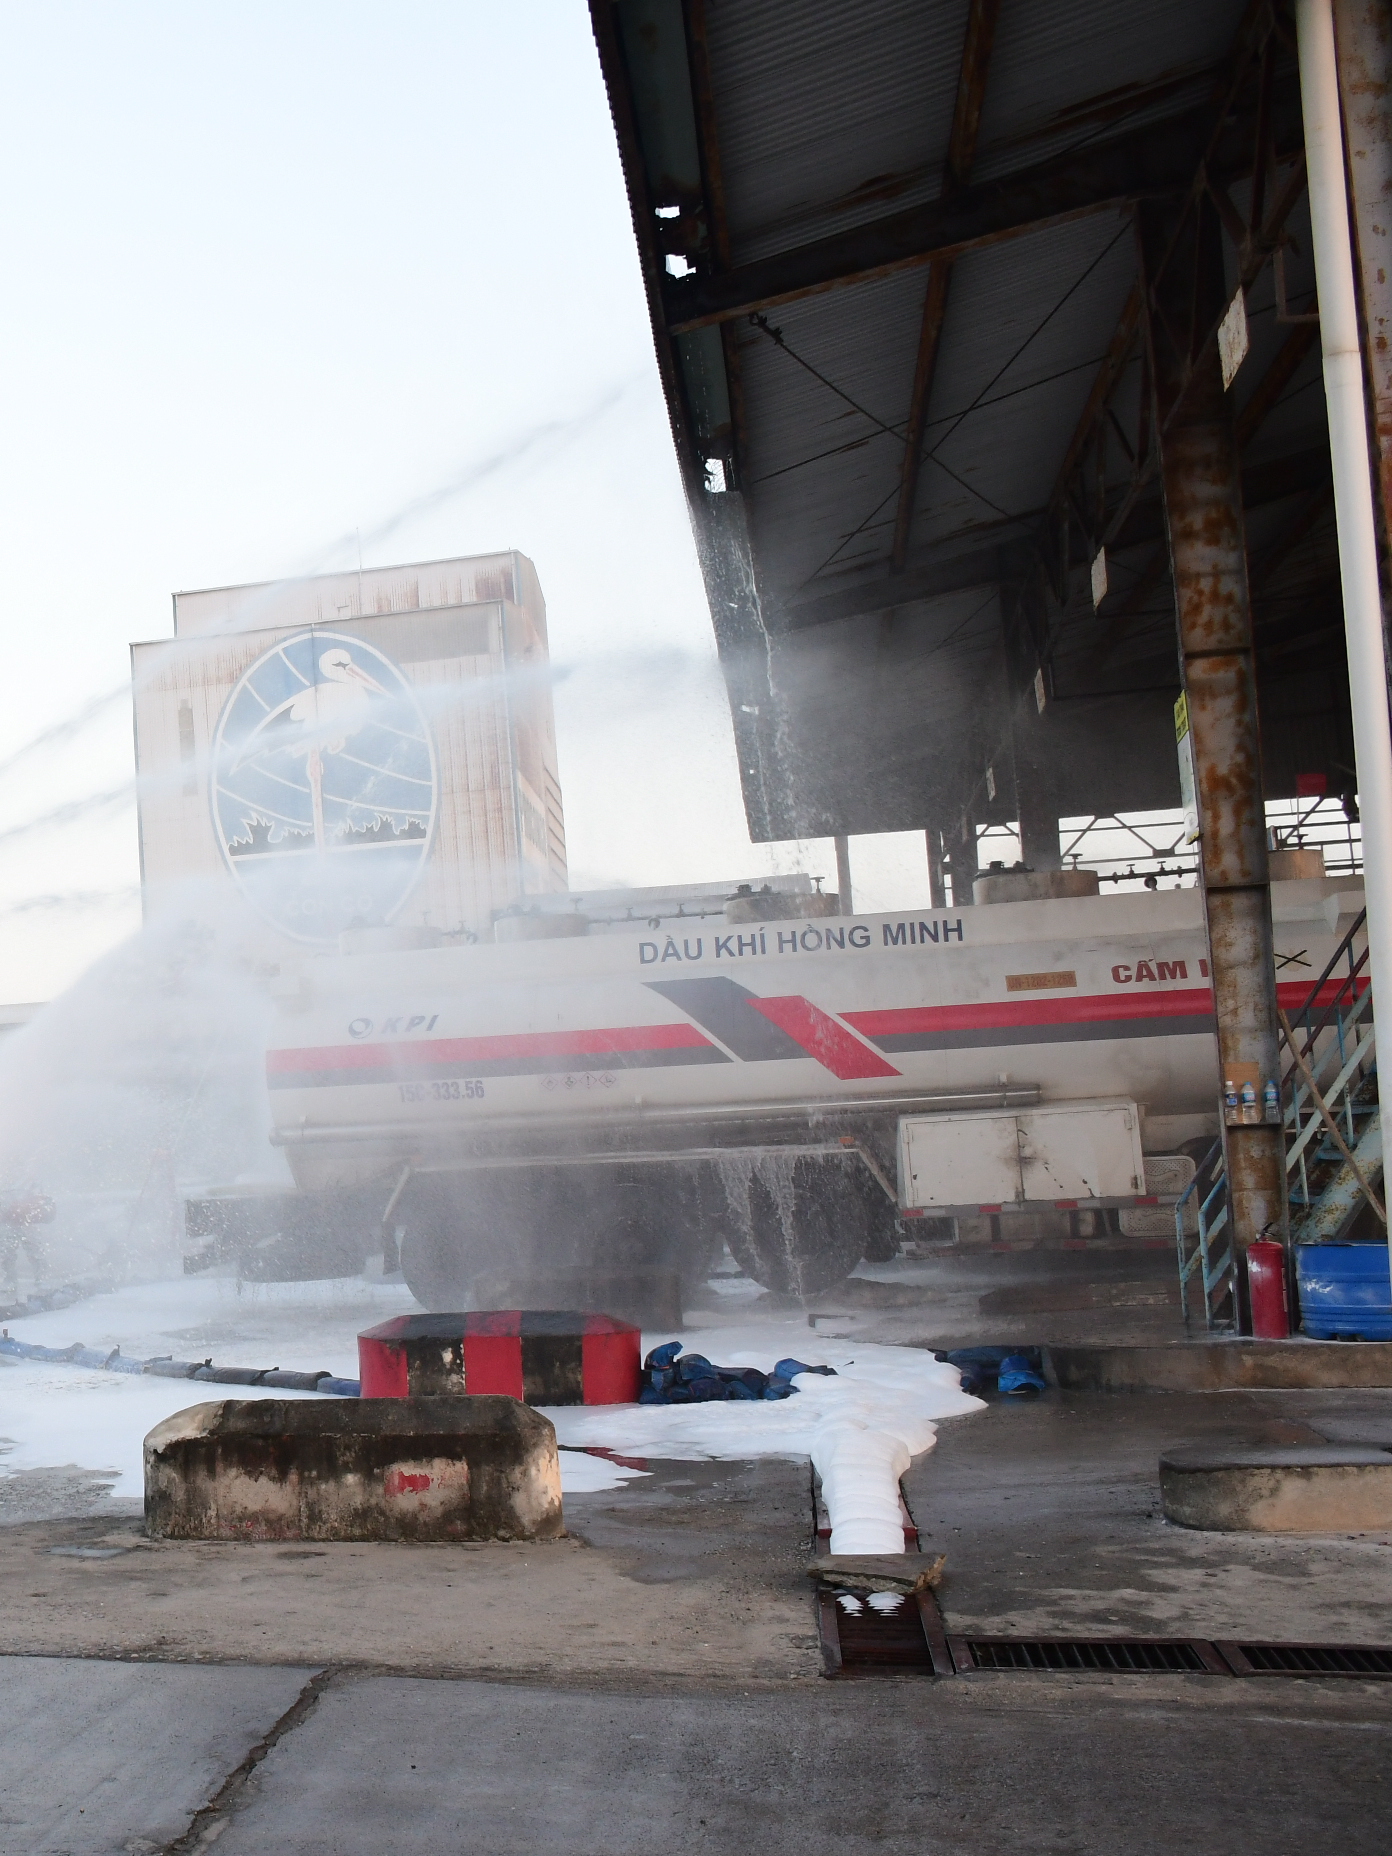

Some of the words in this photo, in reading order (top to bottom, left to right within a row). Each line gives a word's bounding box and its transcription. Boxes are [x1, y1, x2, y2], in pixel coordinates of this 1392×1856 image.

[639, 935, 703, 965] DẦU
[714, 926, 767, 959] KHÍ
[777, 923, 871, 954] HỒNG
[882, 918, 964, 947] MINH
[1111, 958, 1188, 984] CẤM
[381, 1014, 440, 1034] KPI
[398, 1080, 485, 1103] 15C-333.56
